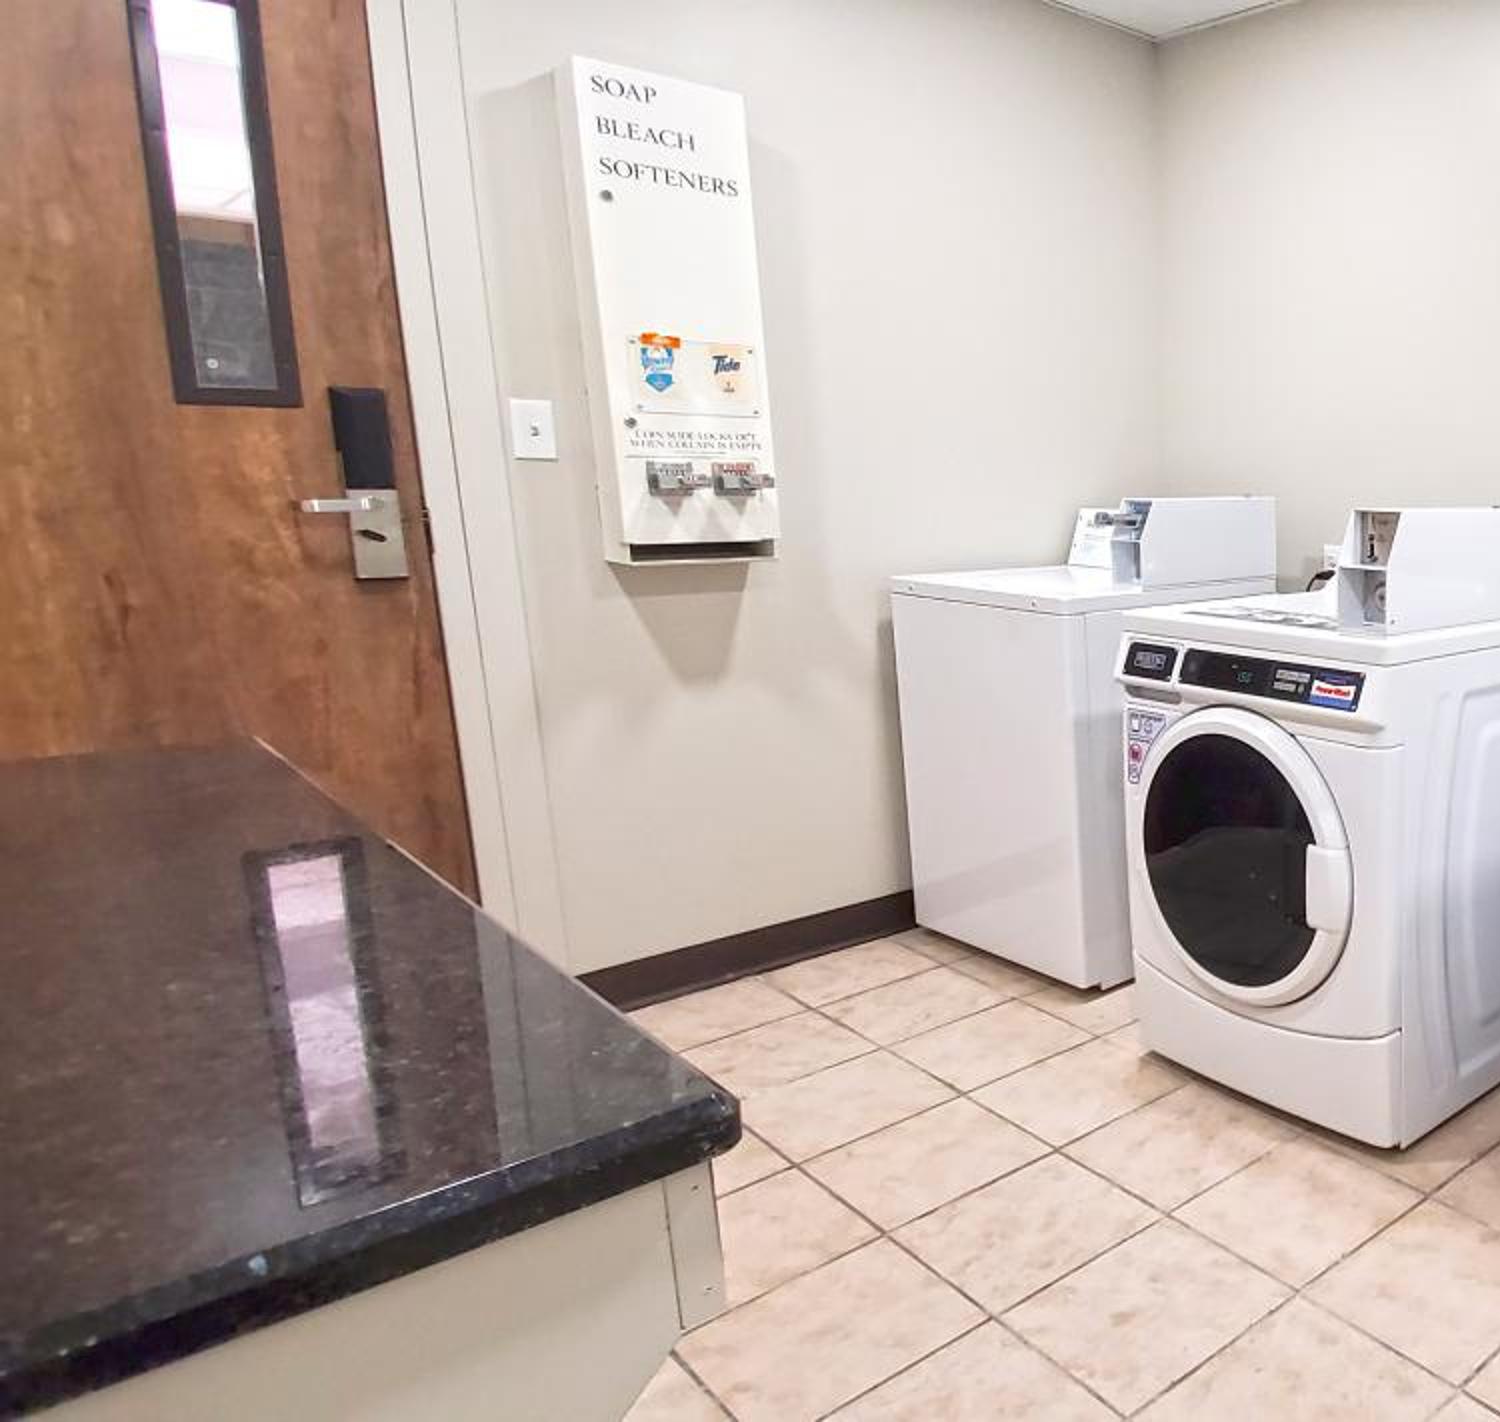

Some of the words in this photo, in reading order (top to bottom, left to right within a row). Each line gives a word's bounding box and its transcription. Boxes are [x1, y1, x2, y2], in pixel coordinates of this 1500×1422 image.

[590, 75, 657, 104] SOAP
[595, 115, 696, 152] BLEACH
[599, 157, 738, 196] SOFTENERS
[712, 355, 741, 375] Tide
